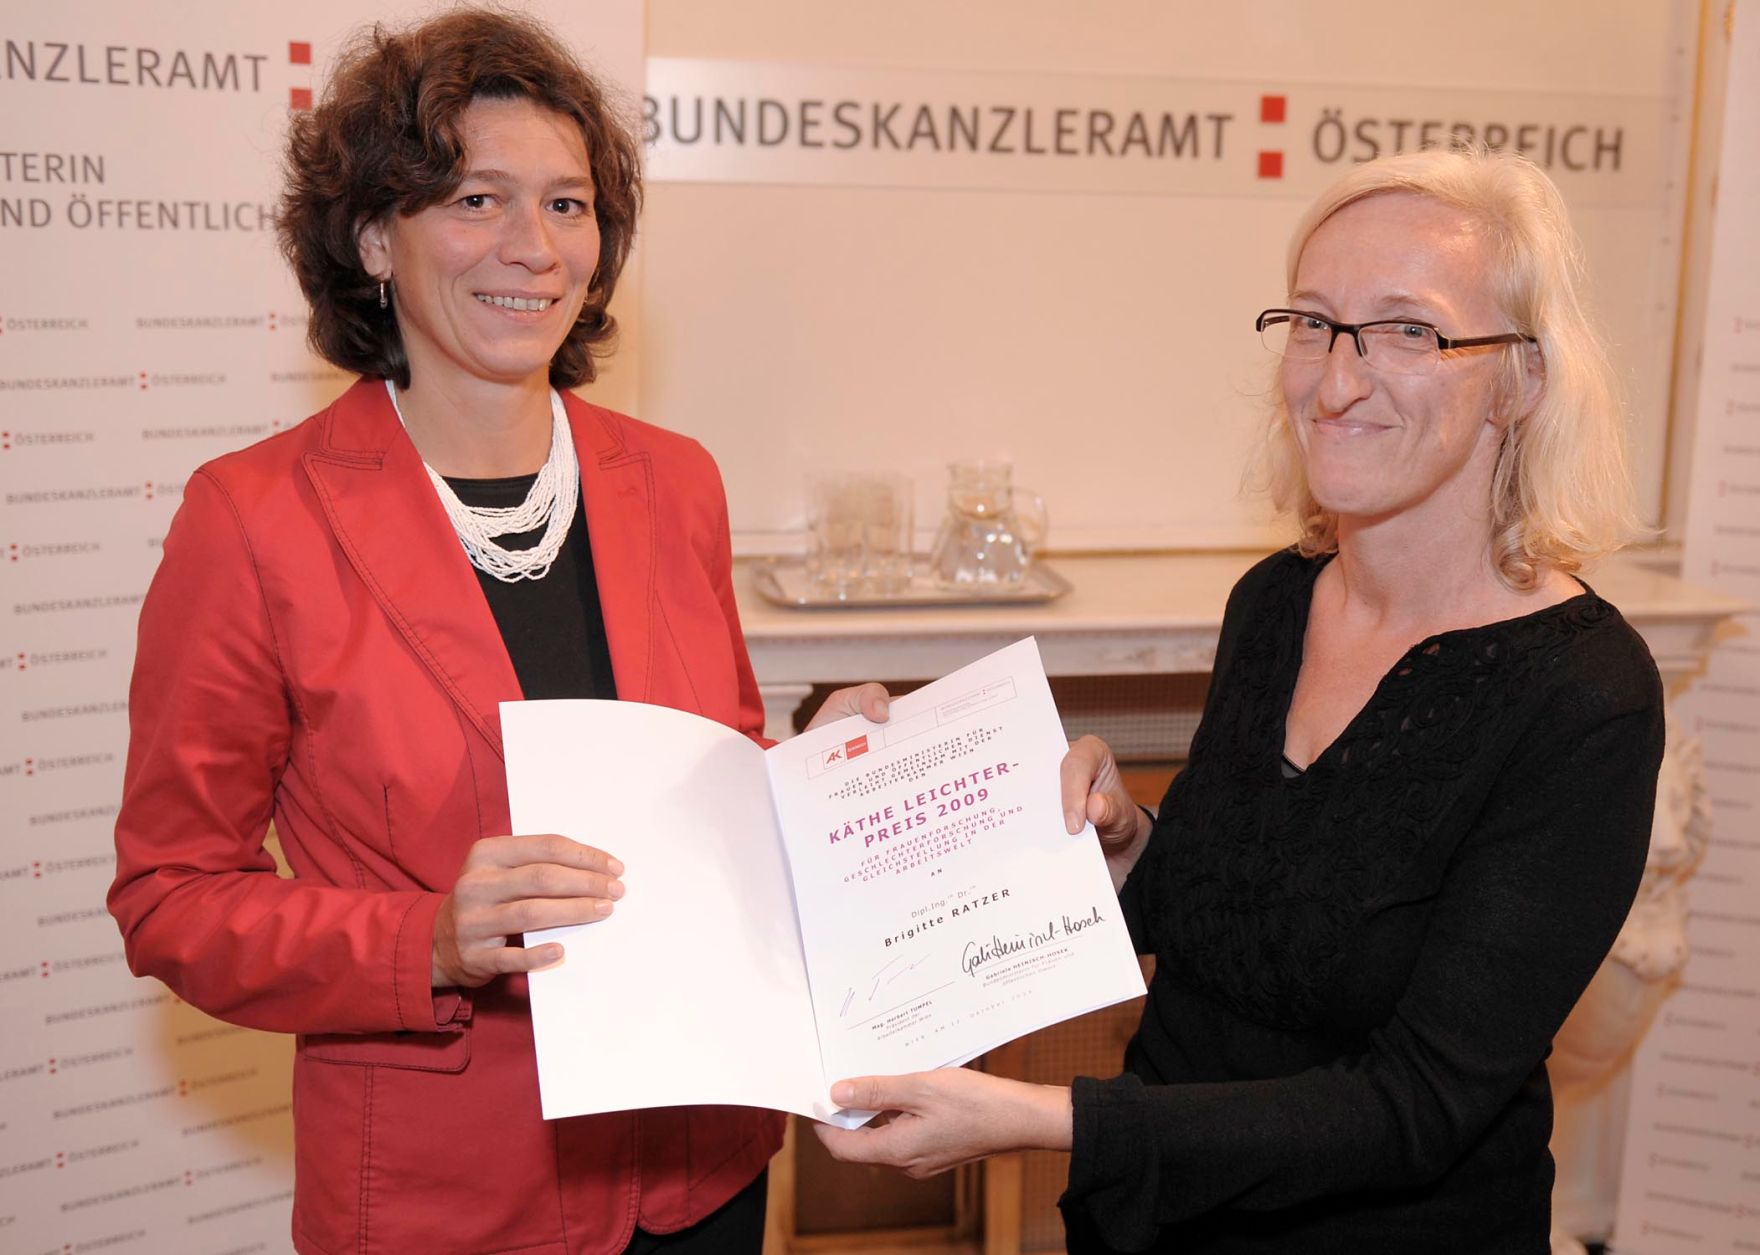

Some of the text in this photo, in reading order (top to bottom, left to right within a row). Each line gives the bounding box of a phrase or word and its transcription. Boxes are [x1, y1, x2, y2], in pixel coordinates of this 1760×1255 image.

[0, 39, 268, 92] NZLERAMT
[643, 95, 1234, 159] BUNDESKANZLERAMT
[826, 749, 842, 764] AK
[829, 762, 1019, 844] KÄTHE LEICHTER-
[864, 788, 988, 848] PREIS 2009
[844, 806, 1023, 882] GESCHLECHTERFORSCHUNG UND
[861, 854, 880, 867] FÜR
[862, 820, 1005, 882] GLEICHSTELLUNG IN DER
[896, 838, 972, 875] ARBEITSWELT
[930, 868, 942, 877] AN
[884, 888, 1010, 947] Brigitte RATZER
